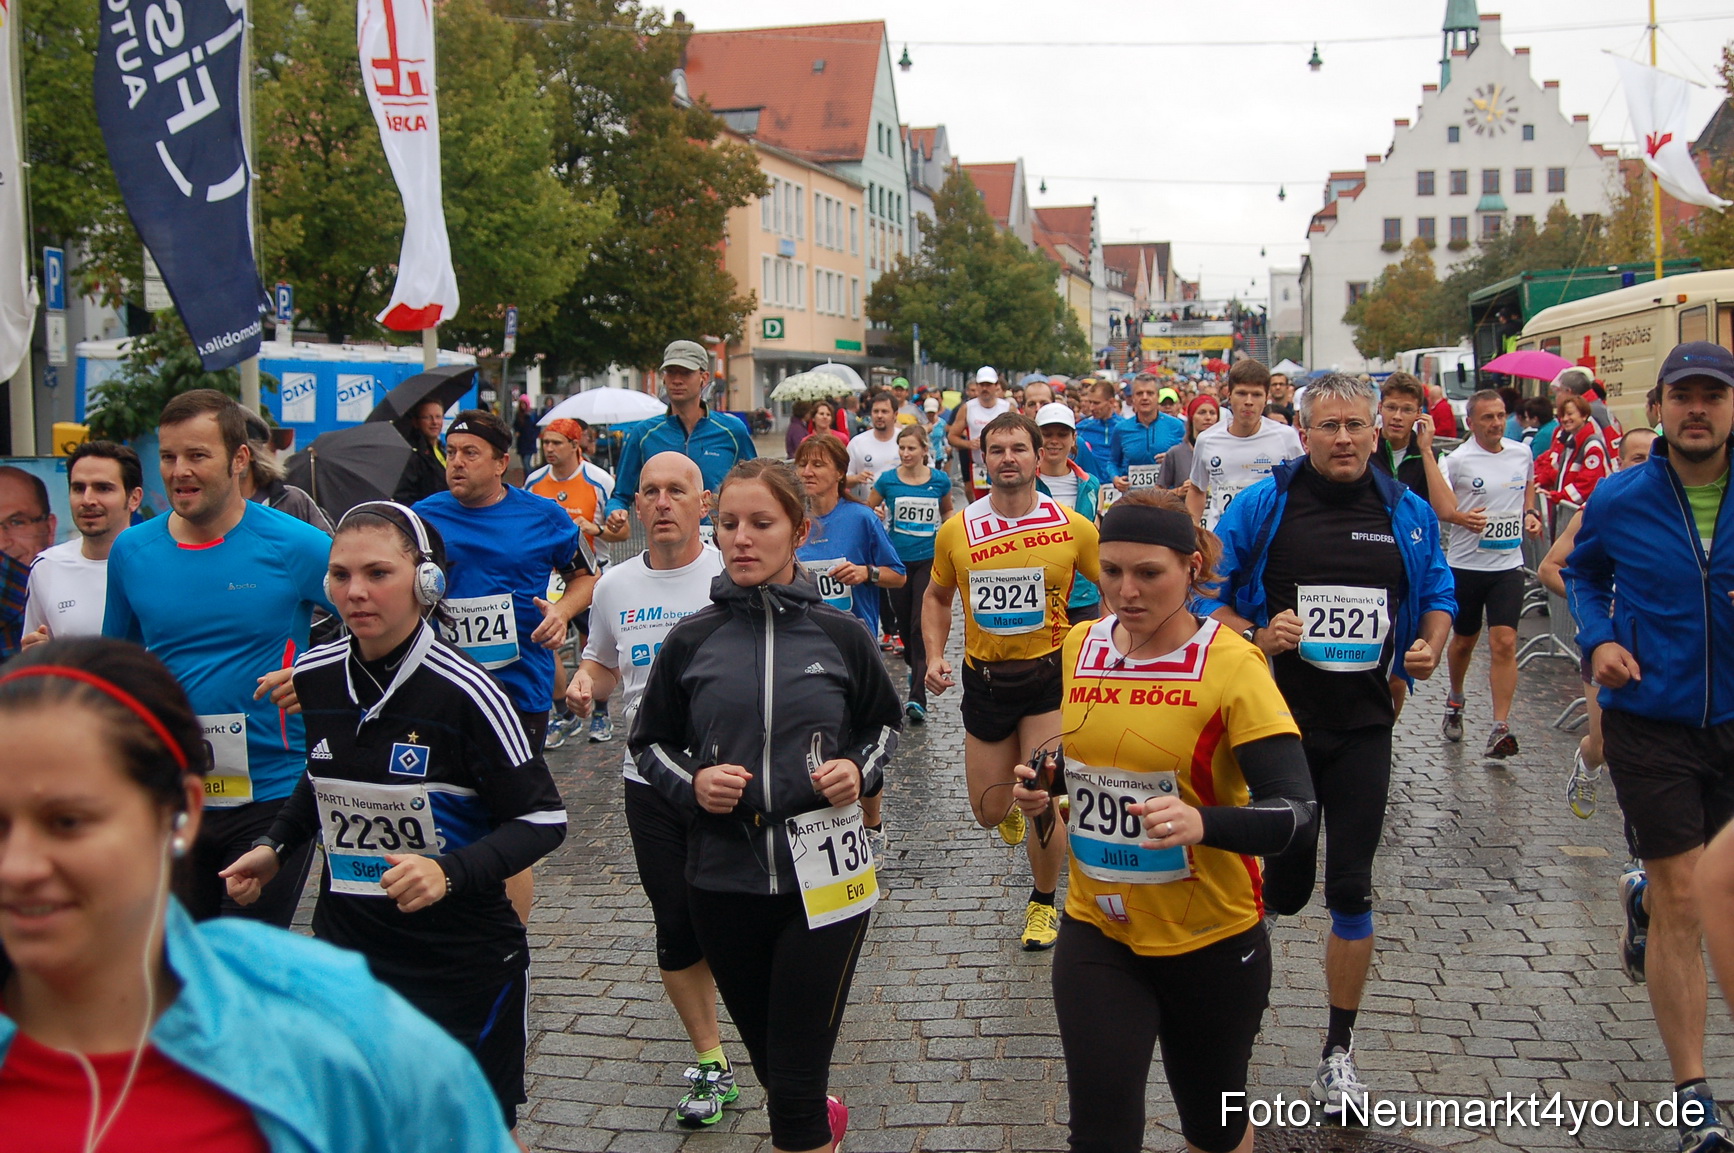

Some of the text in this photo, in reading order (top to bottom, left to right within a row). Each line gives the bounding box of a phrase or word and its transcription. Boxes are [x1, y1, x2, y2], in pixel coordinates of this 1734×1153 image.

[49, 256, 60, 303] P
[279, 288, 290, 317] P
[764, 319, 782, 338] D
[1600, 325, 1652, 353] Bayerisches
[1600, 354, 1624, 375] Rotes
[1131, 473, 1160, 486] 2356
[898, 506, 935, 522] 2619
[1484, 520, 1520, 539] 2886
[970, 530, 1074, 564] MAX BÖGL
[970, 575, 1031, 584] PARTL Neumarkt
[977, 584, 1039, 611] 2924
[1300, 594, 1374, 605] PARTL Neumarkt
[461, 603, 498, 614] Neumarkt
[619, 606, 663, 625] TEAM
[447, 613, 509, 644] 3124
[993, 616, 1024, 626] Marco
[1308, 607, 1379, 639] 2521
[1324, 646, 1366, 660] Werner
[1068, 685, 1198, 707] MAX BÖGL
[204, 779, 226, 794] ael
[1065, 768, 1155, 791] PARTL Neumarkt
[317, 790, 406, 812] PARTL Neumarkt
[1076, 787, 1158, 839] 296
[330, 809, 427, 851] 2239
[792, 812, 860, 838] ARTL Neuma
[817, 824, 869, 877] 138
[1101, 847, 1139, 867] Julia
[352, 860, 394, 879] Stefa
[846, 882, 865, 901] Eva
